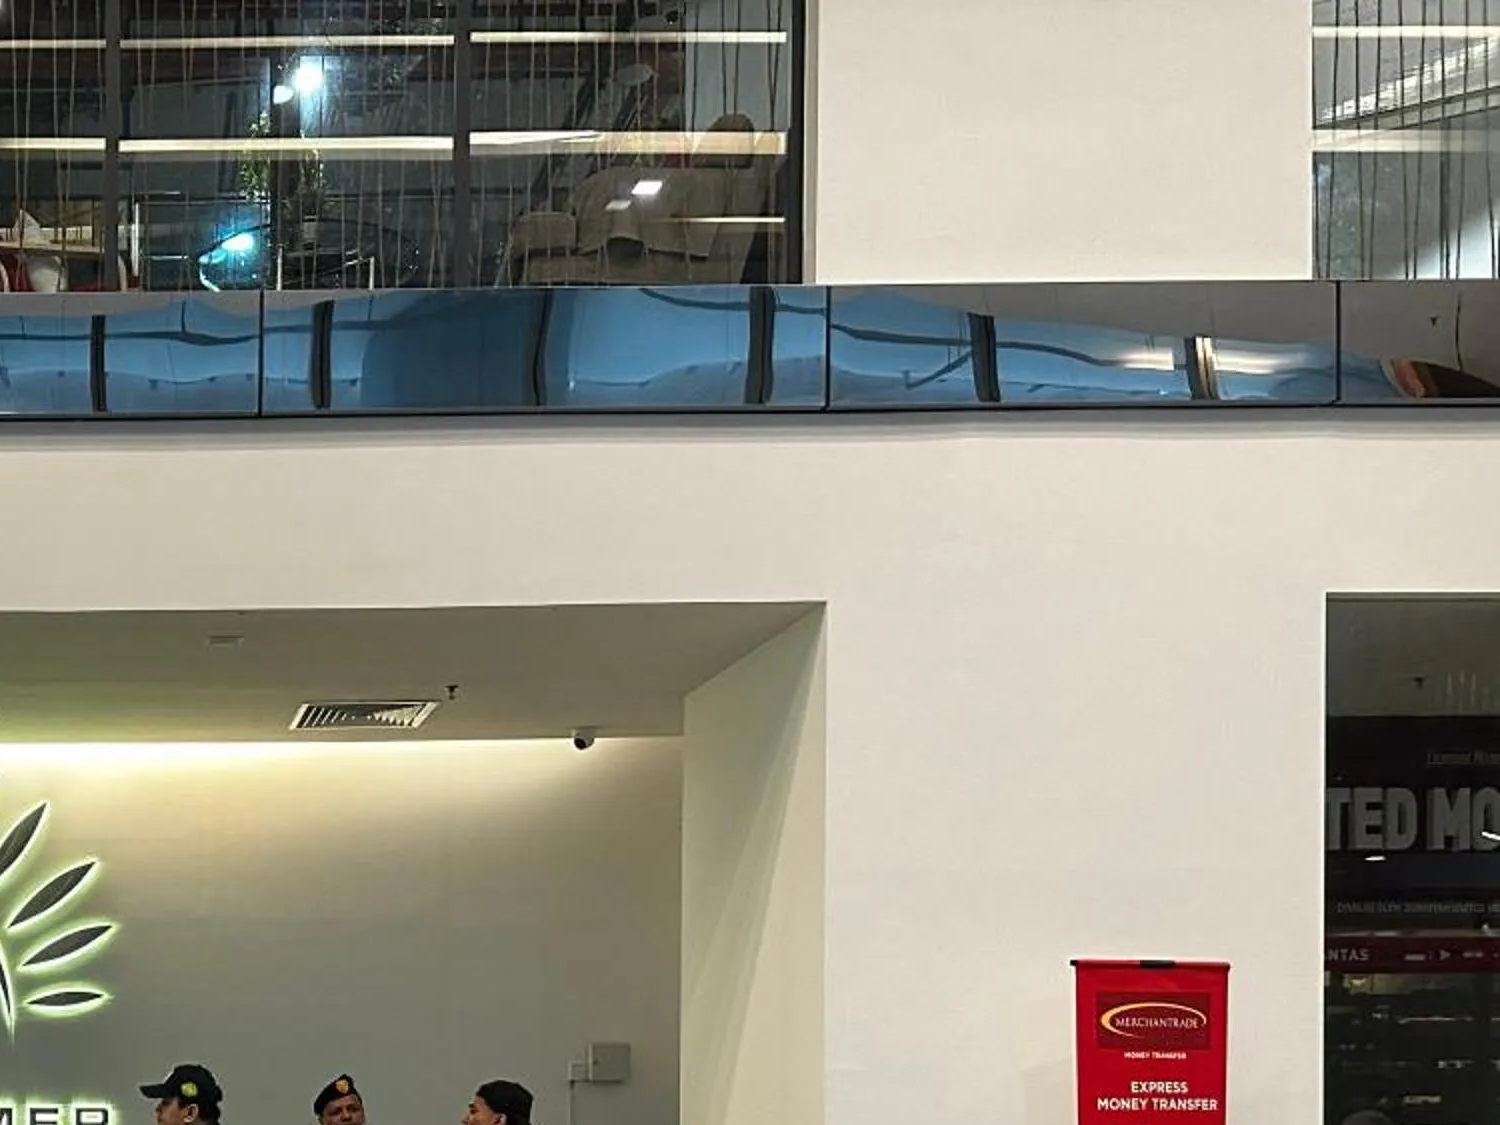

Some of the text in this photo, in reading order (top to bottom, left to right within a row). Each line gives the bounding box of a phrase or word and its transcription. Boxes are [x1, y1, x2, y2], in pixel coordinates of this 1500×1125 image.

[1327, 949, 1369, 961] NTAS
[1115, 1016, 1198, 1029] MERCHANTRADE
[1124, 1051, 1187, 1060] MONEY TRANSFER
[1130, 1081, 1188, 1093] EXPRESS
[1096, 1097, 1218, 1111] MONEY TRANSFER
